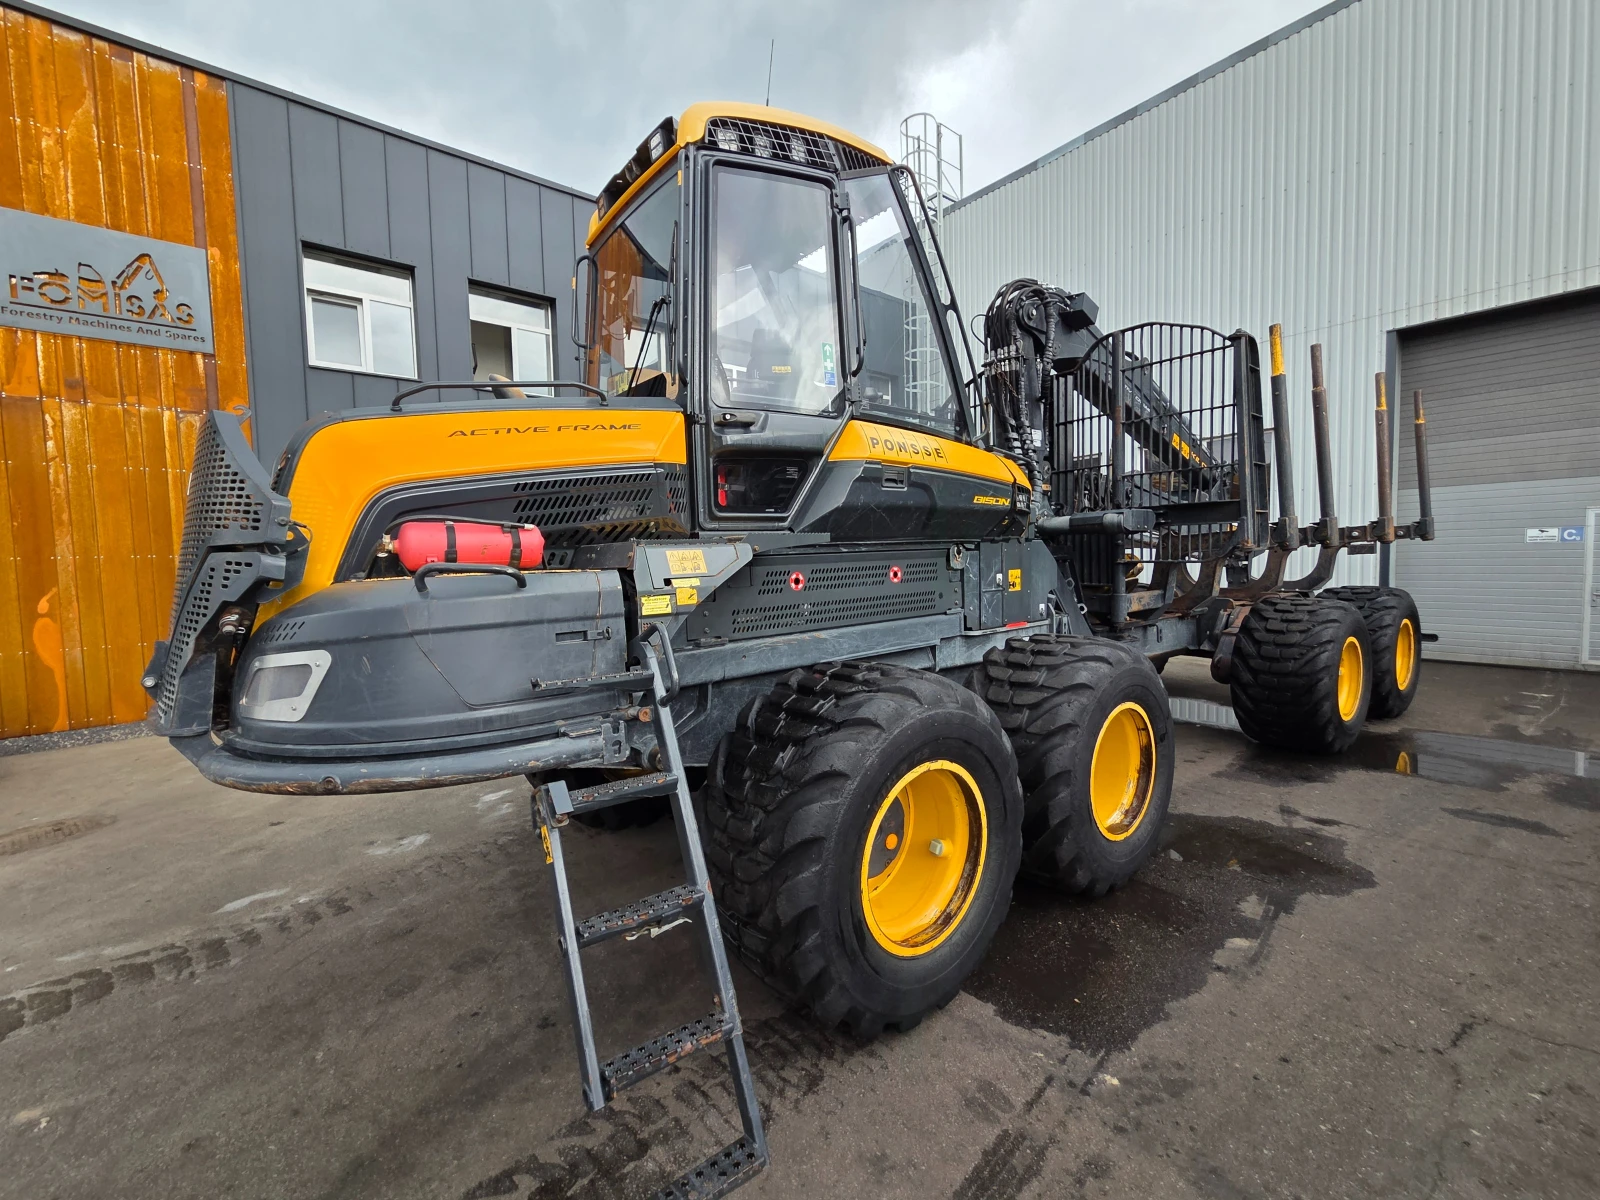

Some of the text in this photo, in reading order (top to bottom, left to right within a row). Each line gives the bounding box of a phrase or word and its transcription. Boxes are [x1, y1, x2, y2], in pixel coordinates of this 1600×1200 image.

[0, 306, 206, 343] Forestry Machines And Spares
[447, 423, 642, 438] ACTIVE FRAME
[870, 436, 944, 459] PONSSE
[973, 495, 1010, 506] BISON
